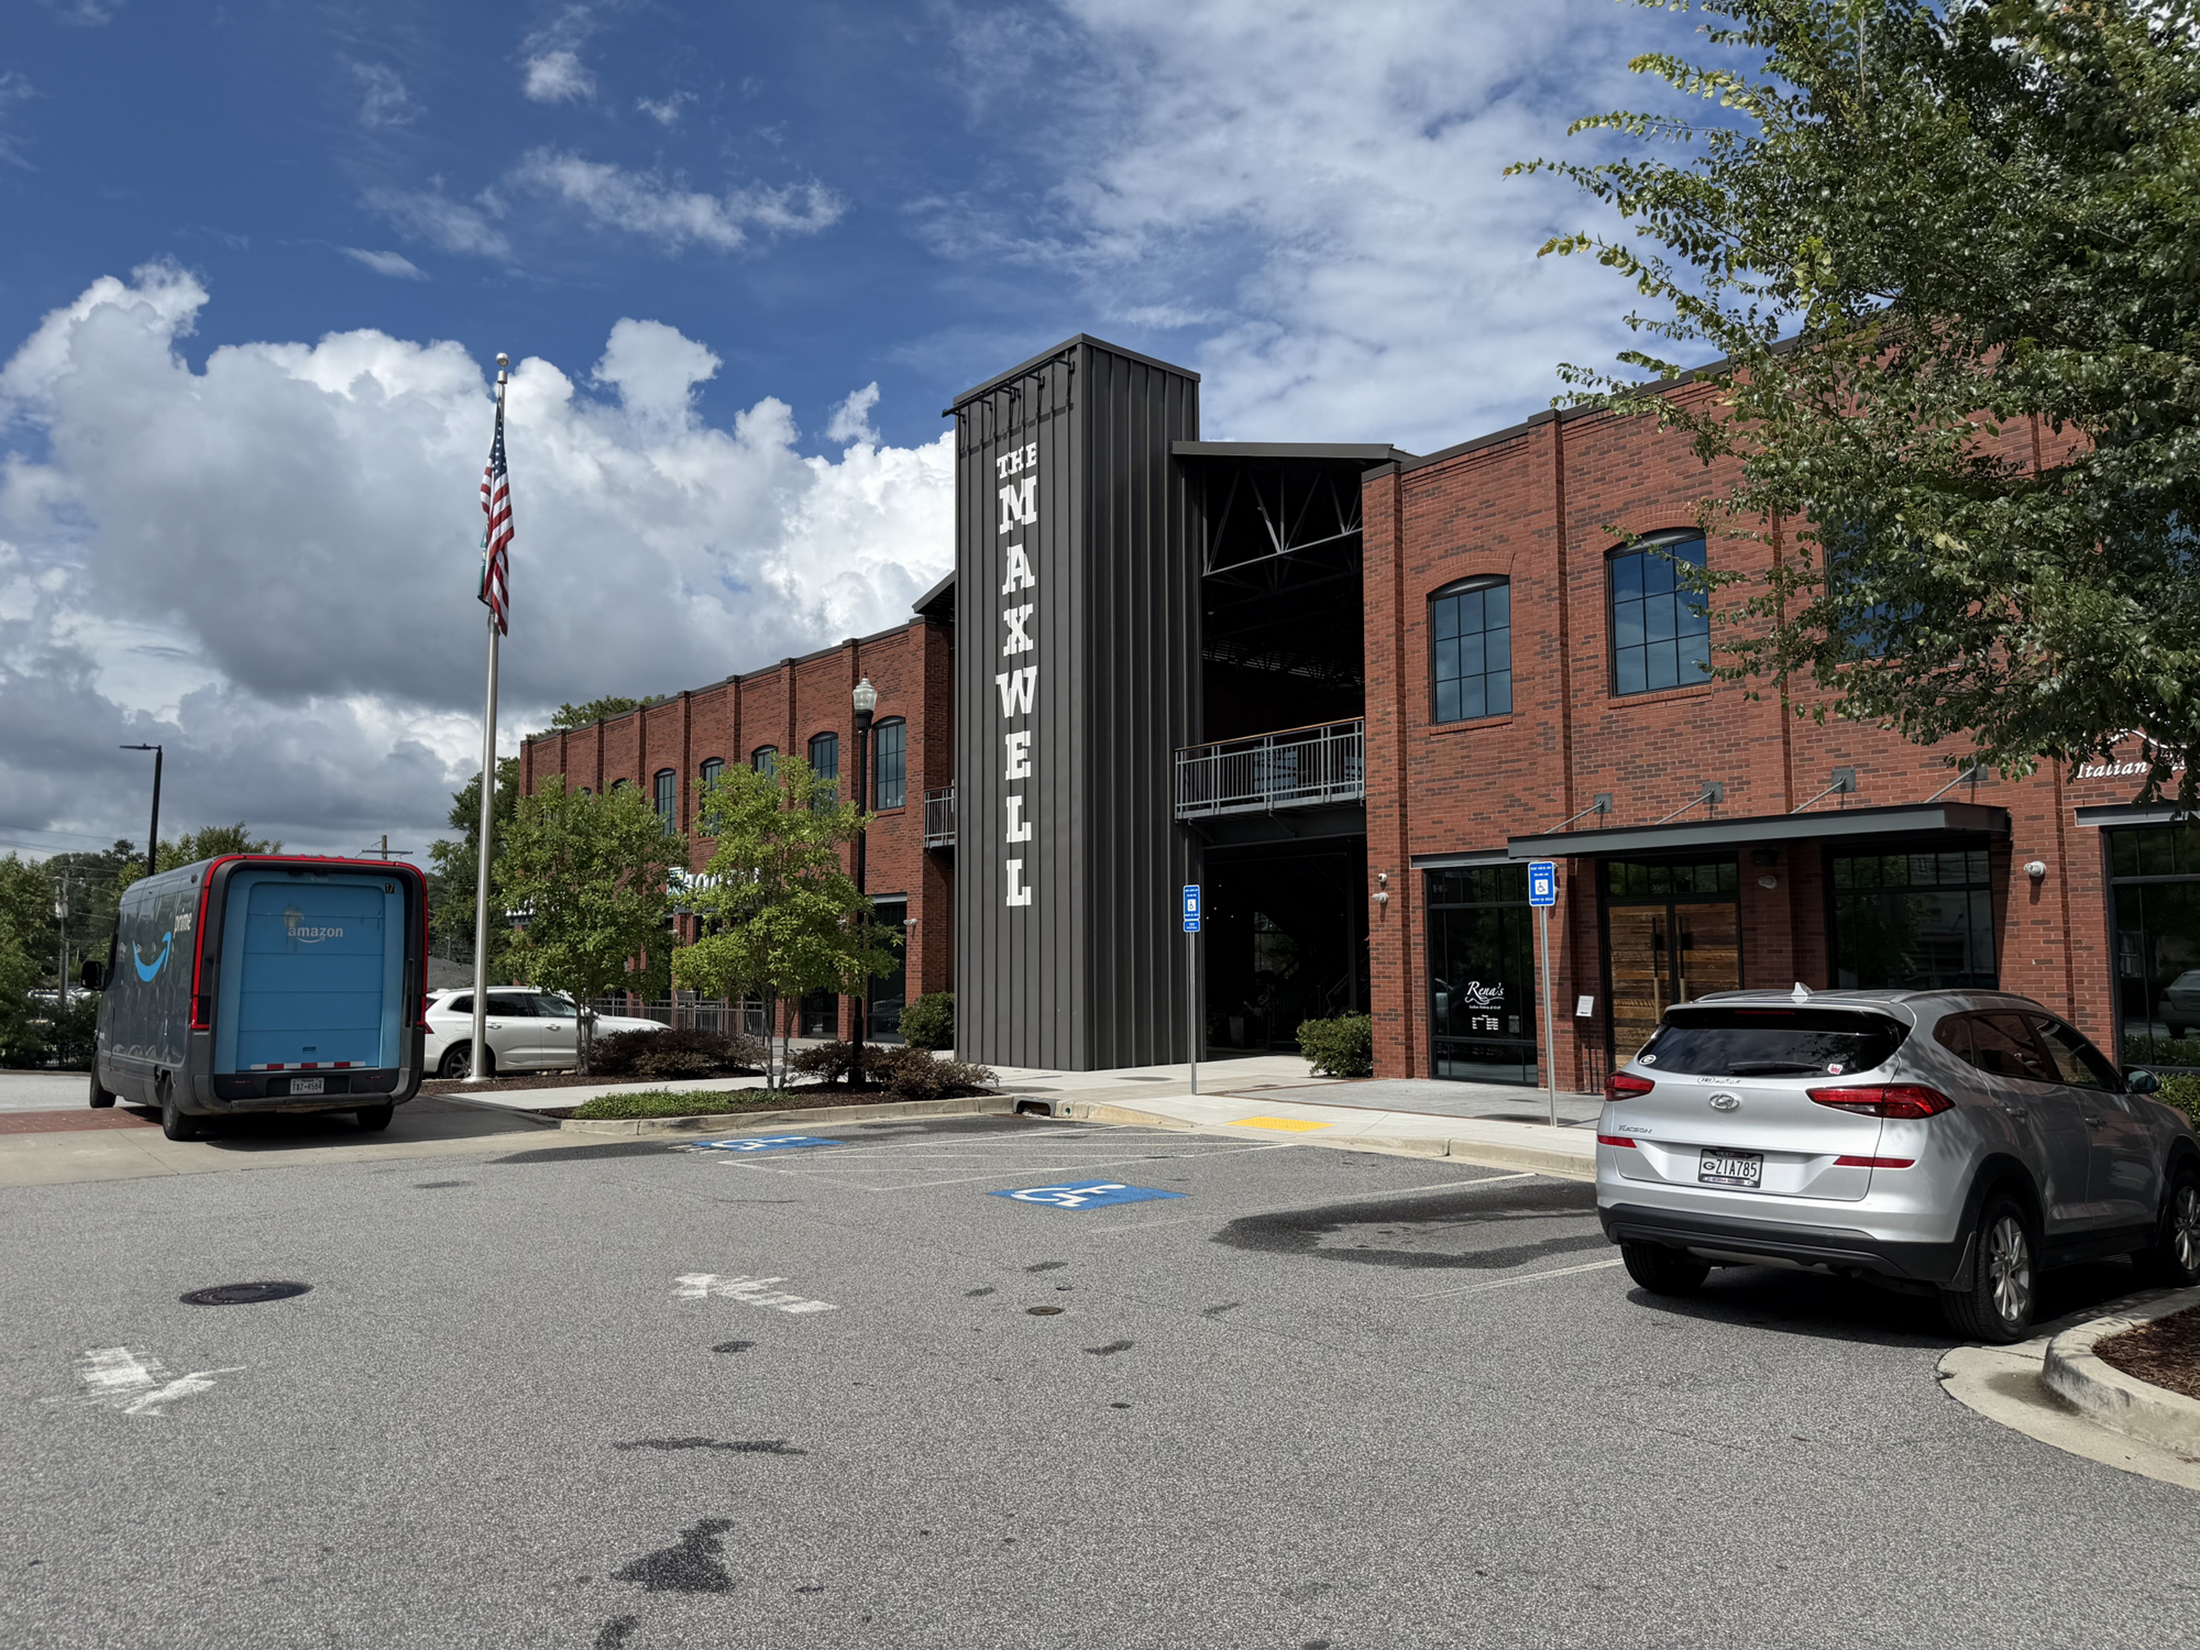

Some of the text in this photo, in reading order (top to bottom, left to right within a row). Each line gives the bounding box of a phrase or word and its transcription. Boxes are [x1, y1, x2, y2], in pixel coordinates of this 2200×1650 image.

[996, 442, 1037, 479] THE
[996, 475, 1037, 907] MAXWELL
[2076, 760, 2147, 779] Italian
[173, 907, 192, 938] prime
[288, 926, 344, 938] amazon
[1467, 981, 1504, 999] Rena's
[1618, 1124, 1652, 1134] TUCSON
[1715, 1159, 1757, 1178] ZIA785
